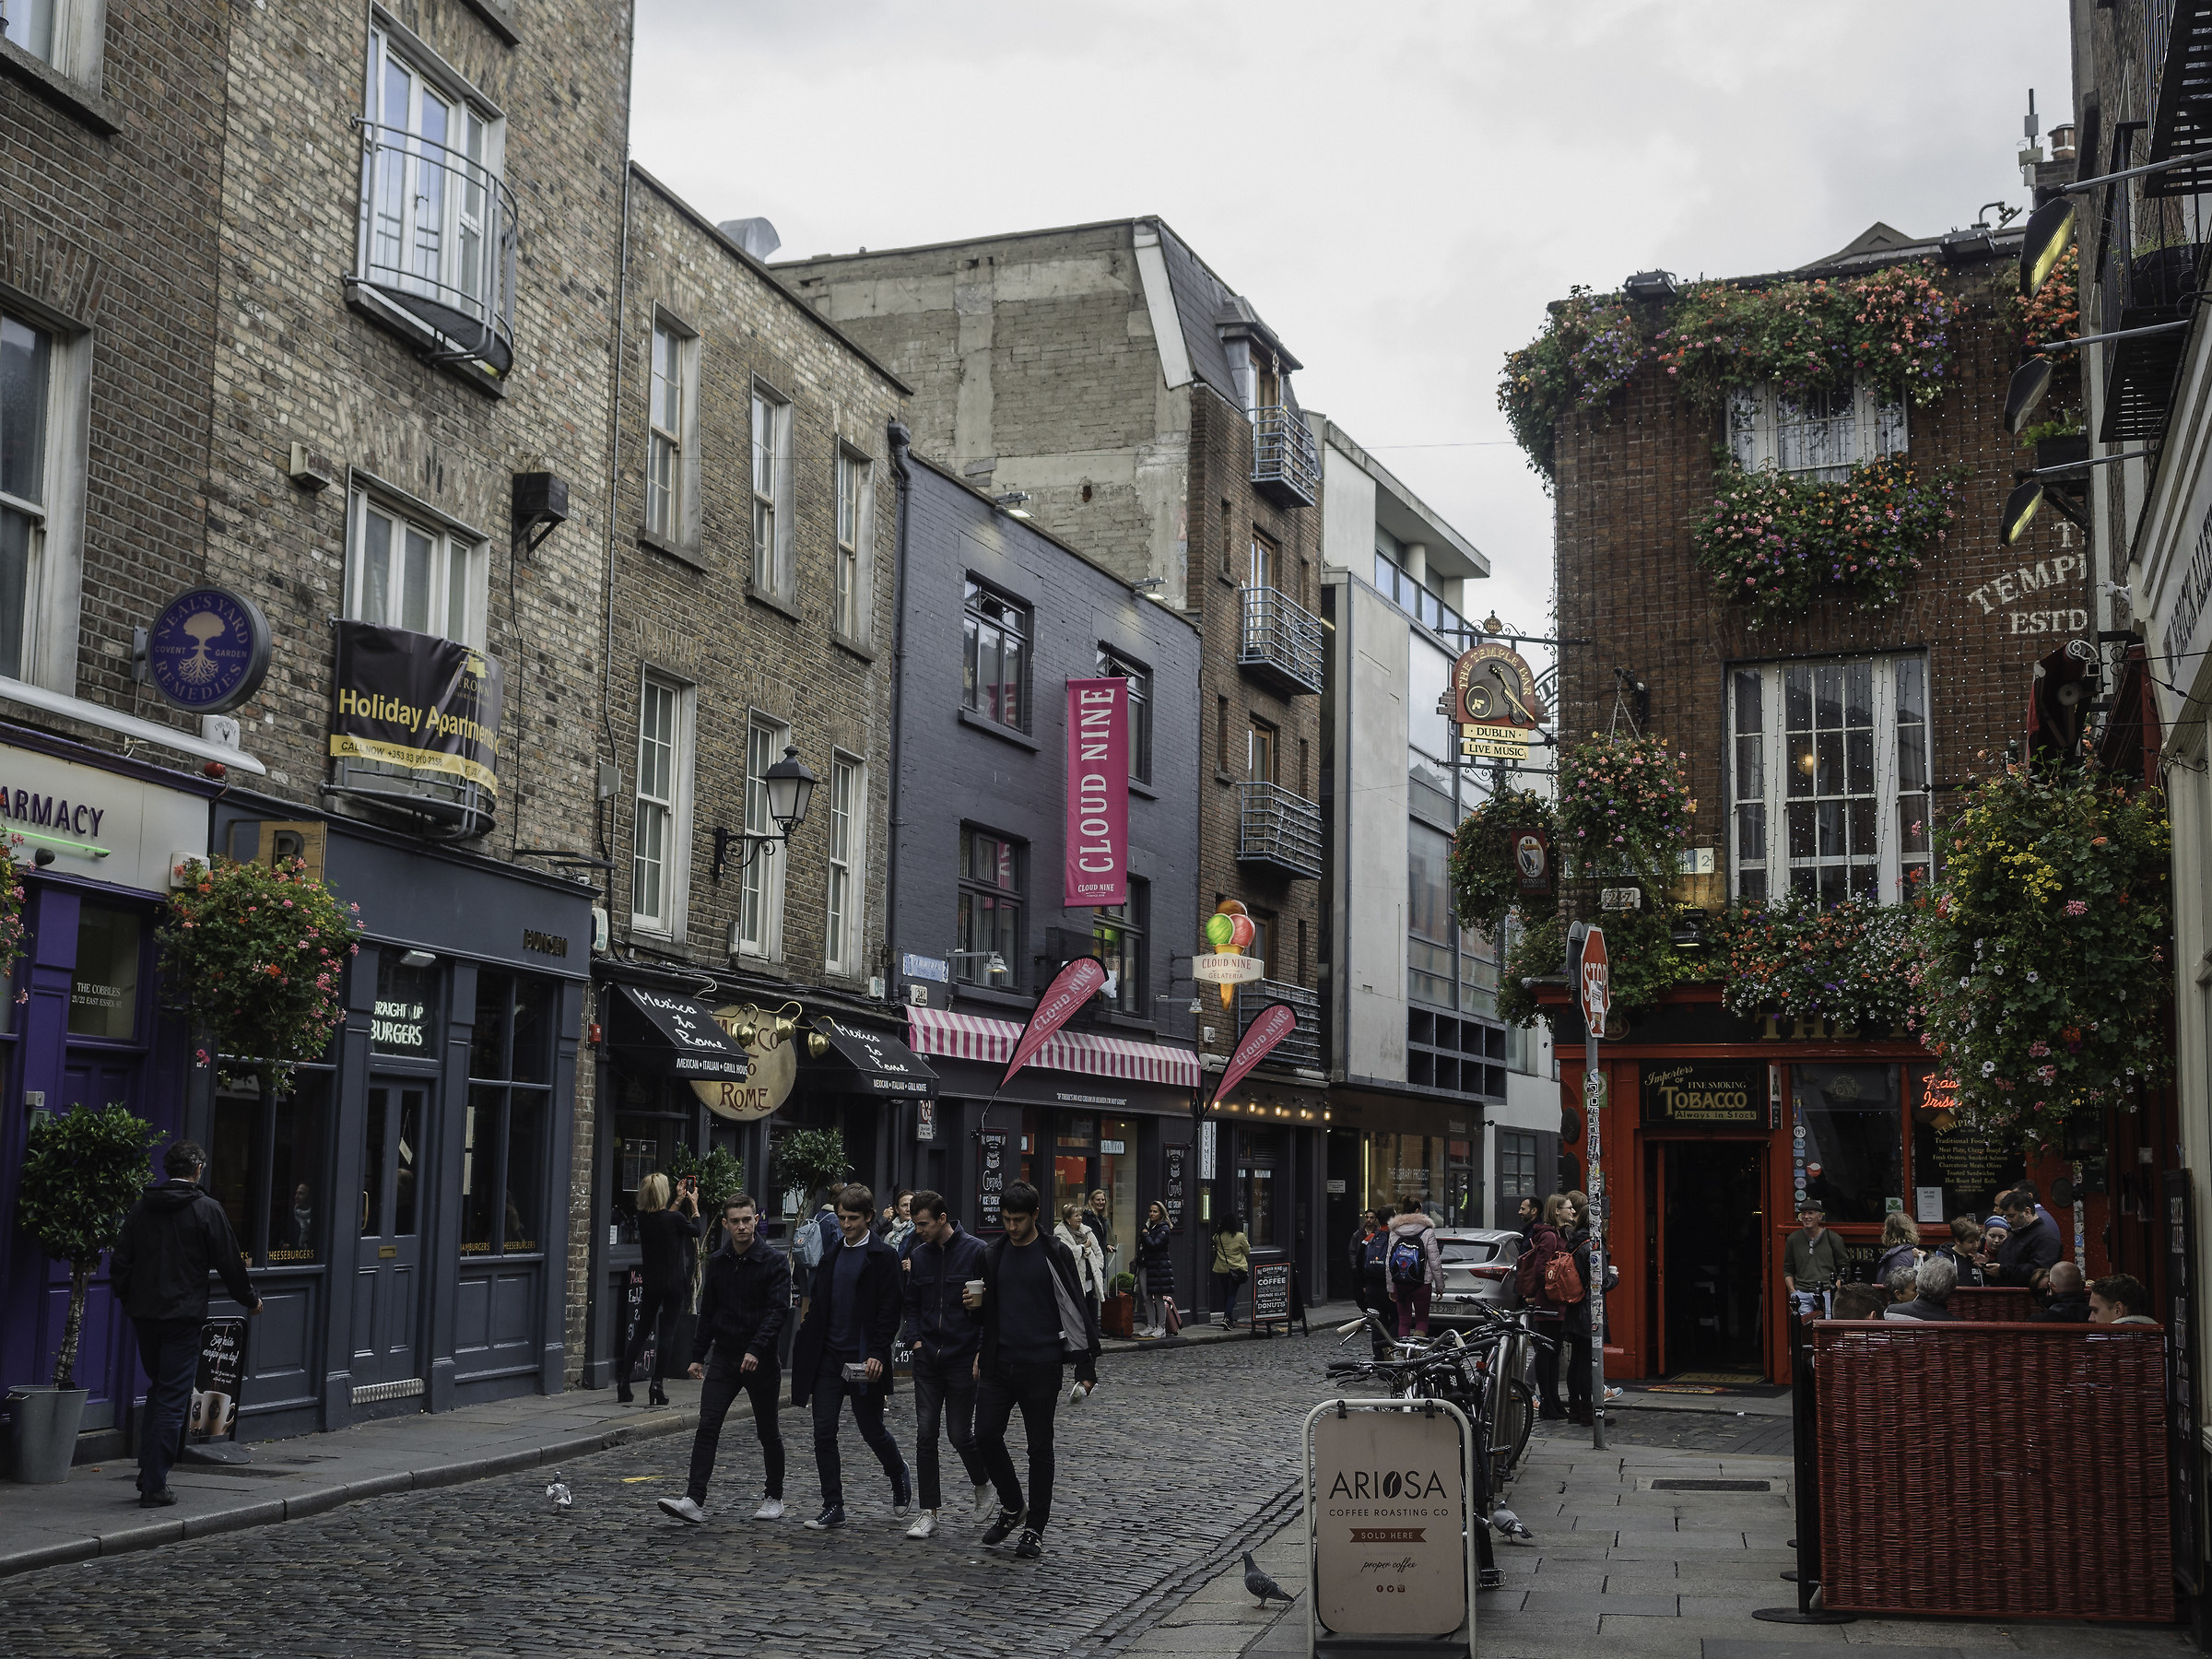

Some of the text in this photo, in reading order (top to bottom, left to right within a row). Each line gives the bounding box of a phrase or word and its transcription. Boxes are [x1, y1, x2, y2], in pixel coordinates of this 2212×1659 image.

[158, 595, 249, 644] NEAL'S YARD
[2009, 609, 2088, 634] ESTD
[2171, 567, 2198, 668] BRICK
[154, 645, 248, 658] COVENT GARDEN
[155, 659, 241, 700] REMEDIES
[1458, 646, 1533, 696] THE TEMPLE BAR
[338, 688, 494, 752] Holiday Apartments
[1477, 727, 1516, 739] DUBLIN
[341, 741, 364, 753] CALL
[365, 745, 385, 756] NOW
[387, 749, 406, 760] +353
[406, 753, 414, 763] 83
[1469, 744, 1525, 757] LIVE MUSIC
[1078, 688, 1115, 873] CLOUD NINE
[1077, 884, 1114, 893] CLOUD NINE
[523, 928, 568, 958] BUNSEN
[1202, 959, 1252, 970] CLOUD NINE
[76, 982, 121, 996] THE COBBLES
[1583, 961, 1607, 1003] STOP
[72, 994, 86, 1005] 21/22
[86, 996, 99, 1006] EAST
[99, 998, 115, 1007] ESSEX
[632, 988, 698, 1015] Mexico
[1033, 994, 1070, 1031] CLOUD
[1068, 963, 1097, 994] NINE
[413, 1005, 424, 1020] UP
[672, 1014, 697, 1030] to
[832, 1022, 880, 1042] Mexico
[1754, 1011, 1862, 1040] THE
[674, 1028, 727, 1051] Rome
[1236, 1034, 1267, 1065] CLOUD
[1265, 1009, 1289, 1035] NINE
[865, 1043, 883, 1056] to
[676, 1057, 700, 1070] MEXICAN
[702, 1060, 720, 1071] ITALIAN
[724, 1062, 735, 1074] GRILL
[869, 1054, 909, 1073] Rome
[873, 1078, 927, 1092] MEXICAN ITALIAN GRILL HOUSE
[1644, 1065, 1693, 1086] Importers
[1708, 1081, 1747, 1089] SMOKING
[719, 1082, 771, 1112] ROME
[1657, 1086, 1748, 1117] TOBACCO
[1676, 1111, 1755, 1120] Always in Stock
[982, 1170, 1003, 1192] Crepes
[1257, 1277, 1286, 1286] COFFEE
[1328, 1469, 1448, 1500] ARIOSA
[1329, 1509, 1369, 1517] COFFEE
[1374, 1509, 1429, 1517] ROASTING
[1360, 1557, 1418, 1573] proper coffee
